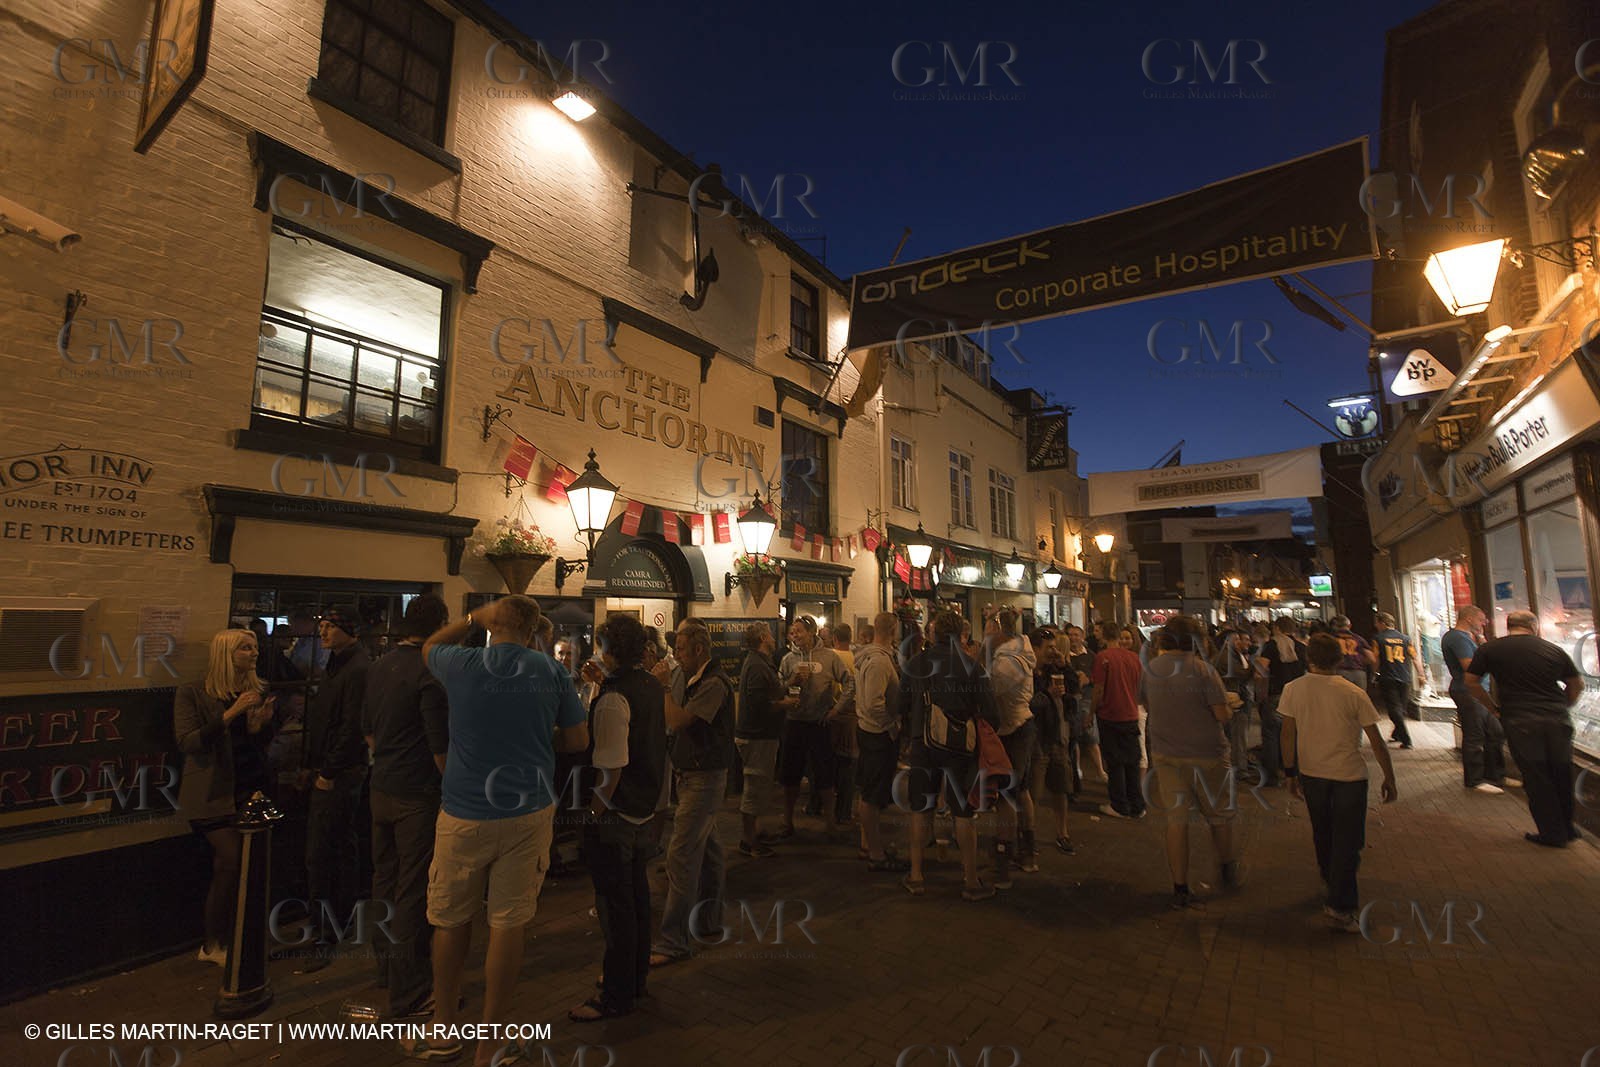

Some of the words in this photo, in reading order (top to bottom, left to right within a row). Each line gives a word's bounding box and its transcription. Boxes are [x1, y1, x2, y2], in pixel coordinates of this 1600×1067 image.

[995, 263, 1141, 310] Corporate
[1155, 223, 1348, 278] Hospitality
[624, 366, 690, 412] THE
[496, 363, 709, 457] ANCHOR
[713, 427, 766, 472] INN
[90, 455, 153, 484] INN
[90, 487, 137, 503] 1704
[5, 499, 57, 511] UNDER
[65, 503, 90, 513] THE
[96, 507, 126, 517] SIGN
[130, 511, 147, 519] OF
[41, 525, 195, 550] TRUMPETERS
[611, 578, 666, 589] RECOMMENDED
[624, 569, 651, 579] CAMRA
